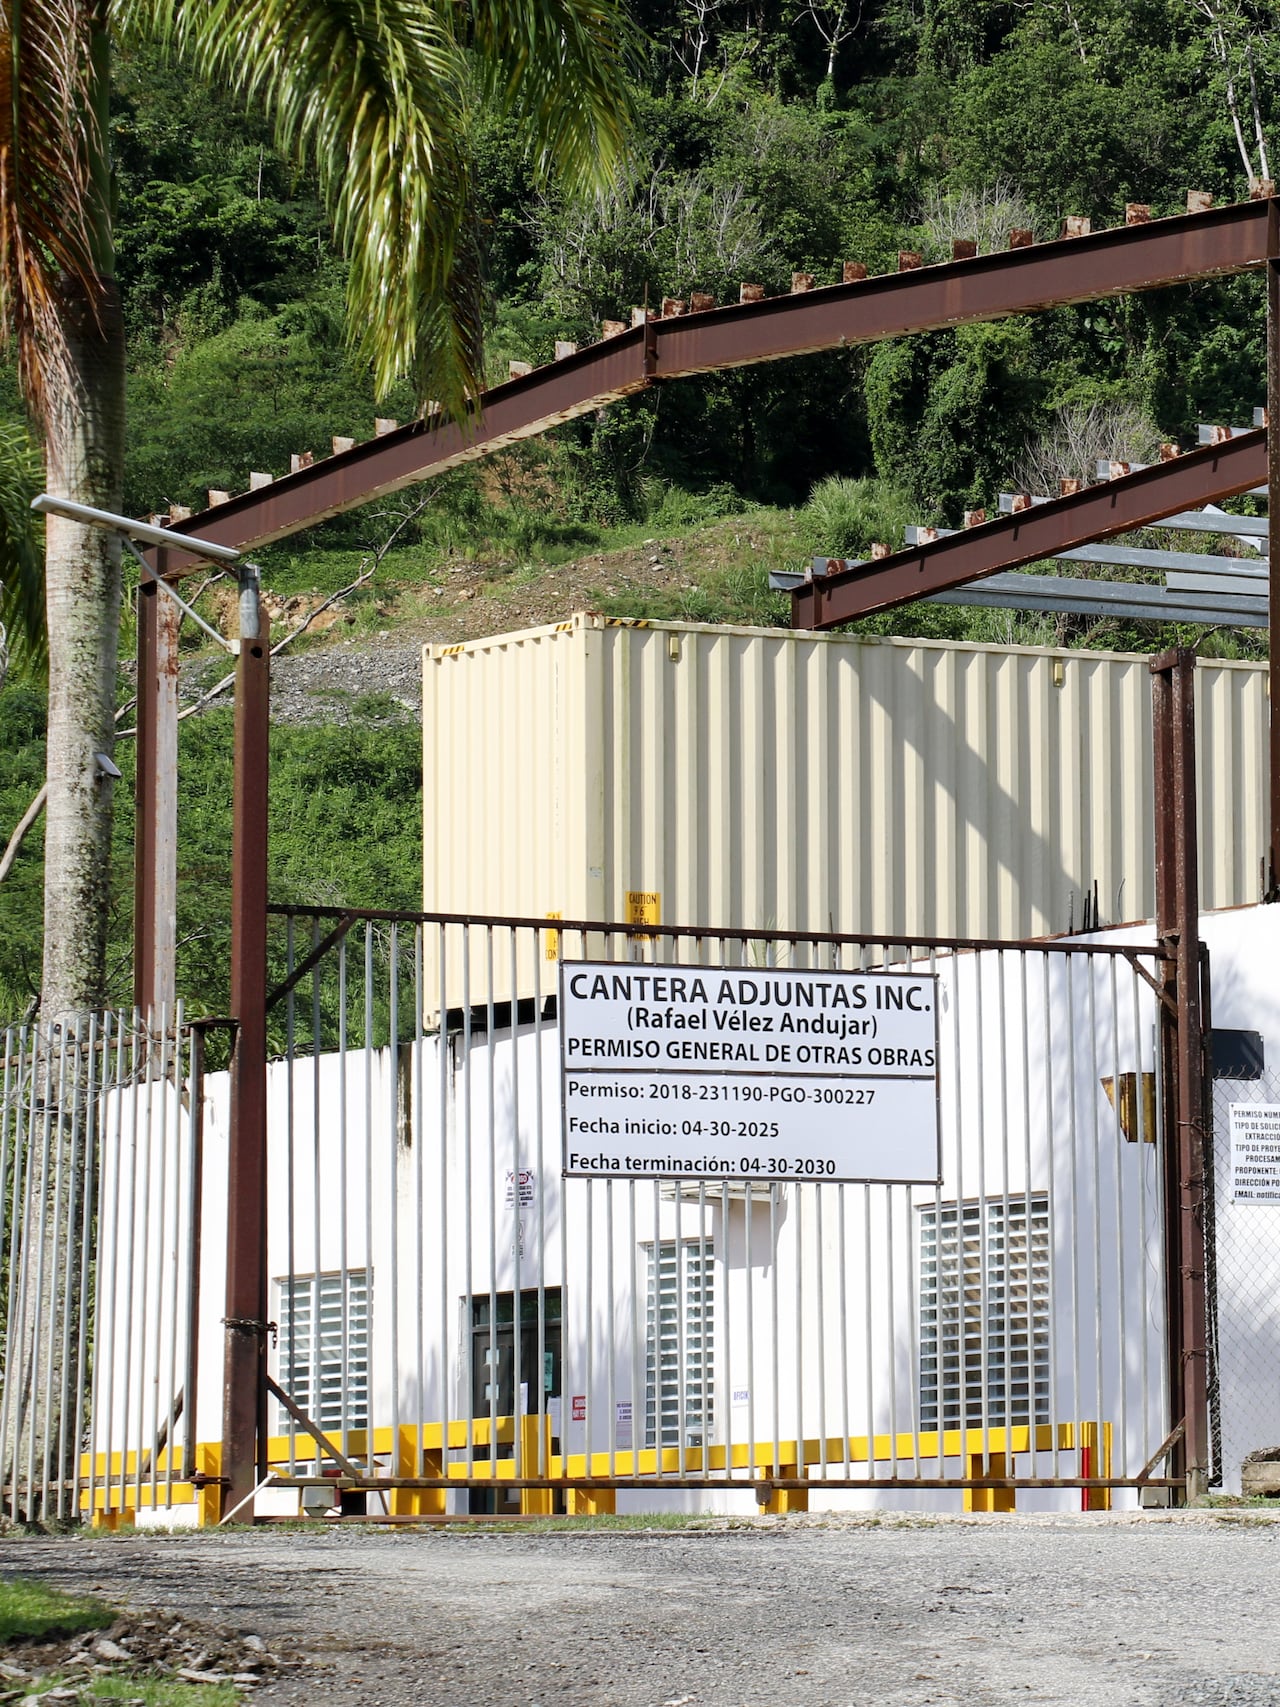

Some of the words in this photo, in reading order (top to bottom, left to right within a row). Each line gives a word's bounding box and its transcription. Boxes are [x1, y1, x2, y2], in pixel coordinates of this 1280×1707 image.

[570, 974, 708, 1003] CANTERA
[718, 980, 866, 1009] ADJUNTAS
[876, 985, 931, 1011] INC.
[627, 1007, 706, 1030] (Rafael
[714, 1010, 773, 1032] Vélez
[780, 1013, 878, 1039] Andujar)
[568, 1039, 660, 1058] PERMISO
[667, 1041, 759, 1061] GENERAL
[766, 1045, 791, 1062] DE
[796, 1045, 862, 1064] OTRAS
[868, 1048, 934, 1067] OBRAS
[569, 1082, 644, 1098] Permiso:
[649, 1084, 875, 1105] 2018-231190-PGO-300227
[570, 1118, 619, 1134] Fecha
[625, 1119, 677, 1135] inicio:
[682, 1121, 779, 1138] 04-30-2025
[1251, 1122, 1259, 1130] DE
[1236, 1144, 1250, 1152] TIPO
[570, 1154, 620, 1171] Fecha
[625, 1156, 736, 1172] terminación:
[740, 1158, 836, 1174] 04-30-2030
[1235, 1167, 1278, 1175] PROPONENTE:
[1235, 1191, 1255, 1199] EMAIL:
